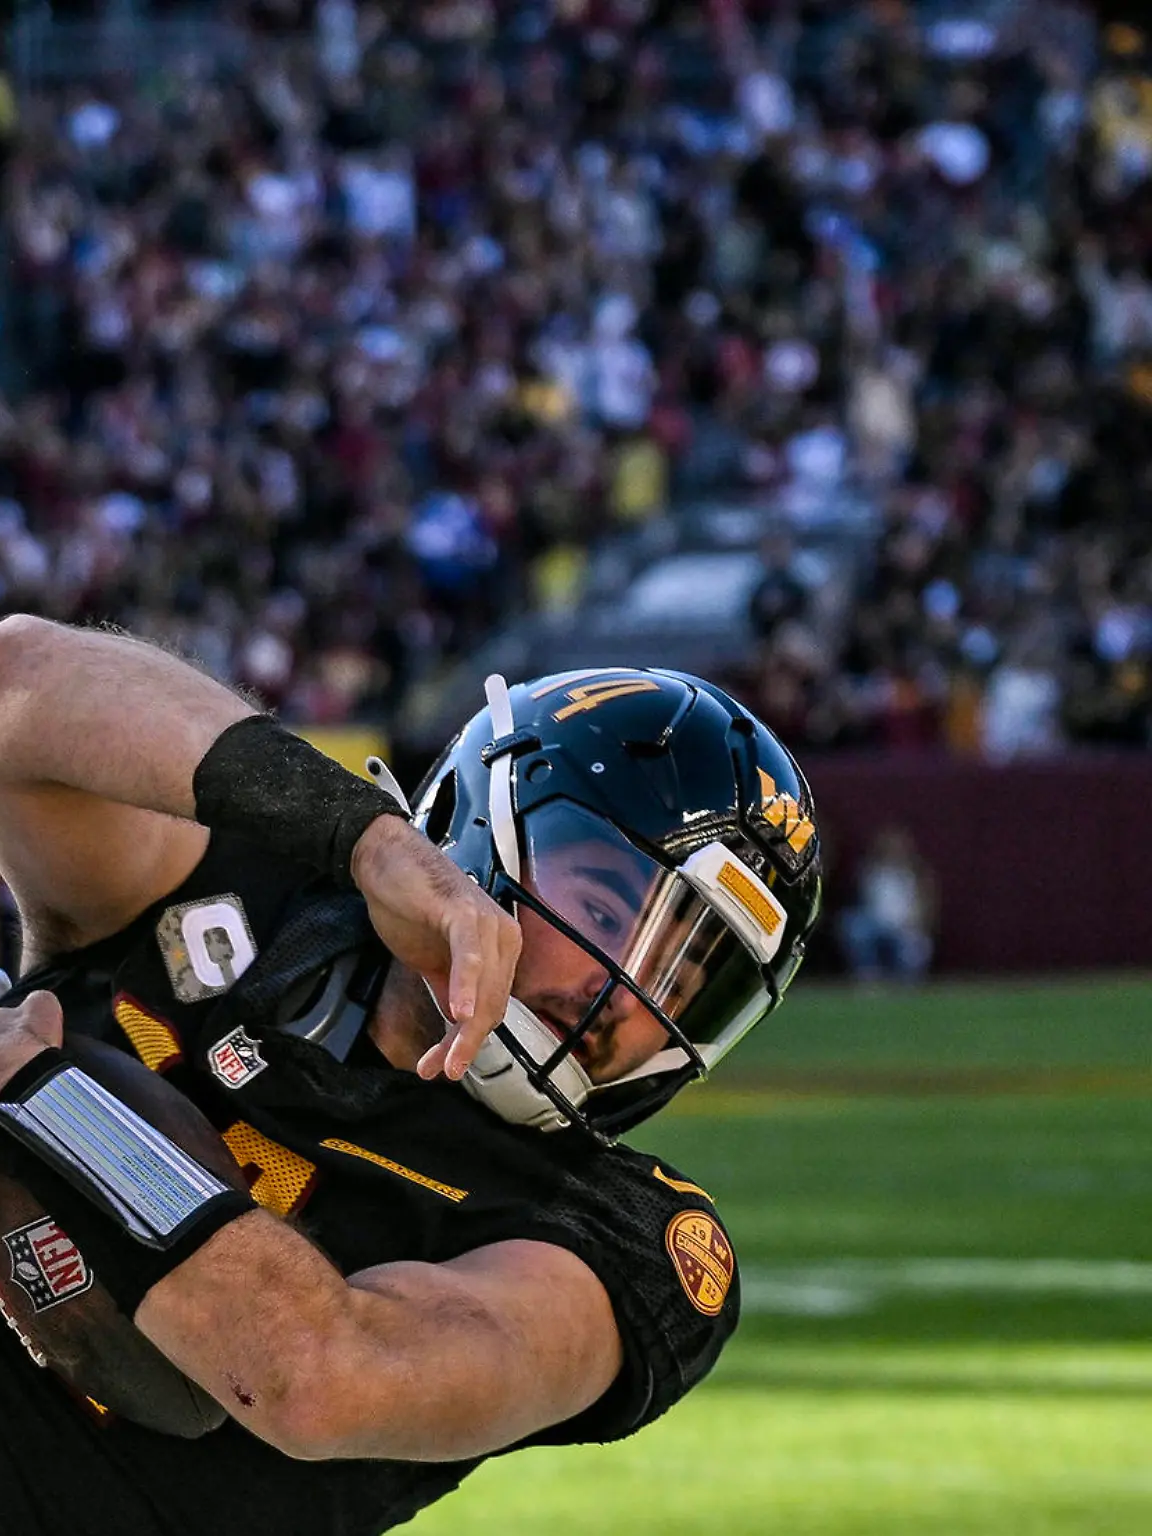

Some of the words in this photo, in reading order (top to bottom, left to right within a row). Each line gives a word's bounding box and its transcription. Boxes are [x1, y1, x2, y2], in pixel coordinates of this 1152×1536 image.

[181, 903, 256, 987] C
[216, 1043, 247, 1082] NFL
[34, 1226, 84, 1293] NFL
